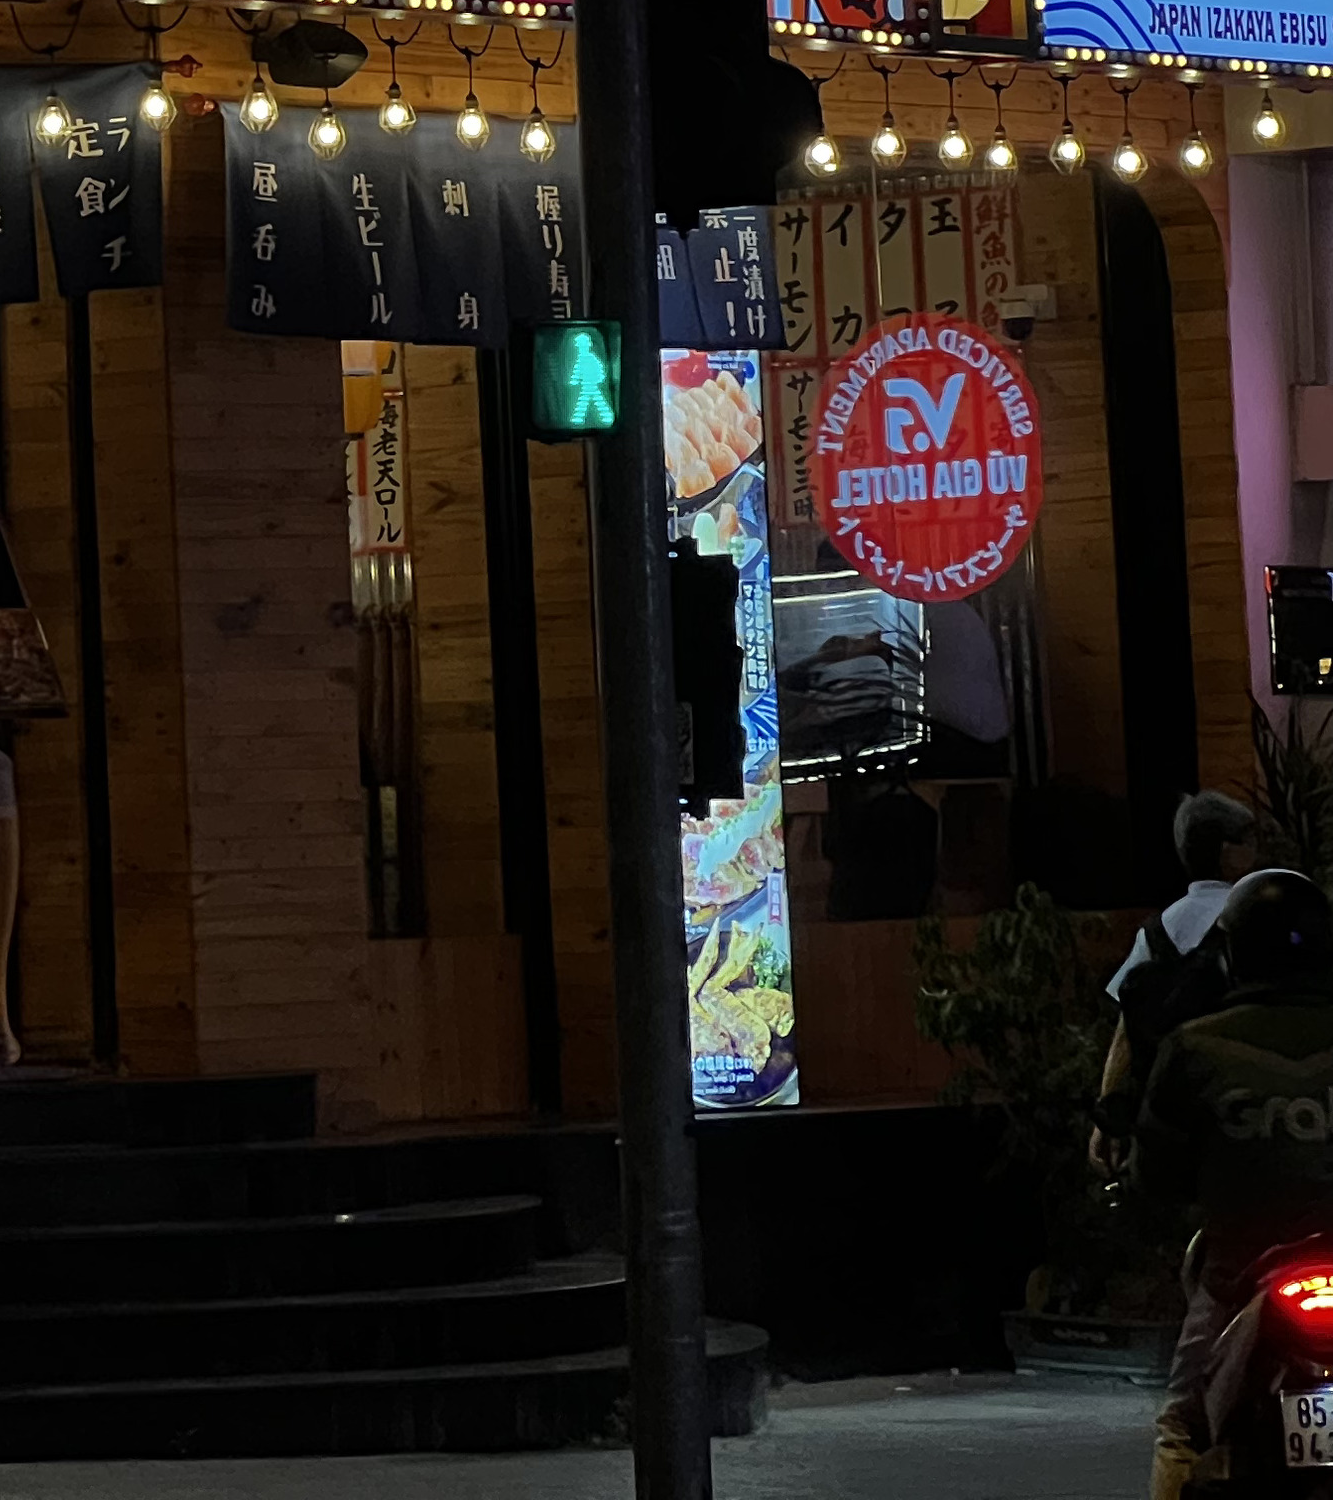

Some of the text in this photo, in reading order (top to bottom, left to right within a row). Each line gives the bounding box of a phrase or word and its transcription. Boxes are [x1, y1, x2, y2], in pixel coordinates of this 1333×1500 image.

[1148, 2, 1327, 47] JAPAN IZAKAYA EBISU
[65, 118, 107, 218] 定食
[351, 173, 393, 325] 生ビール
[441, 178, 481, 331] 刺身
[779, 206, 813, 353] サーモン
[826, 203, 864, 346] イカ
